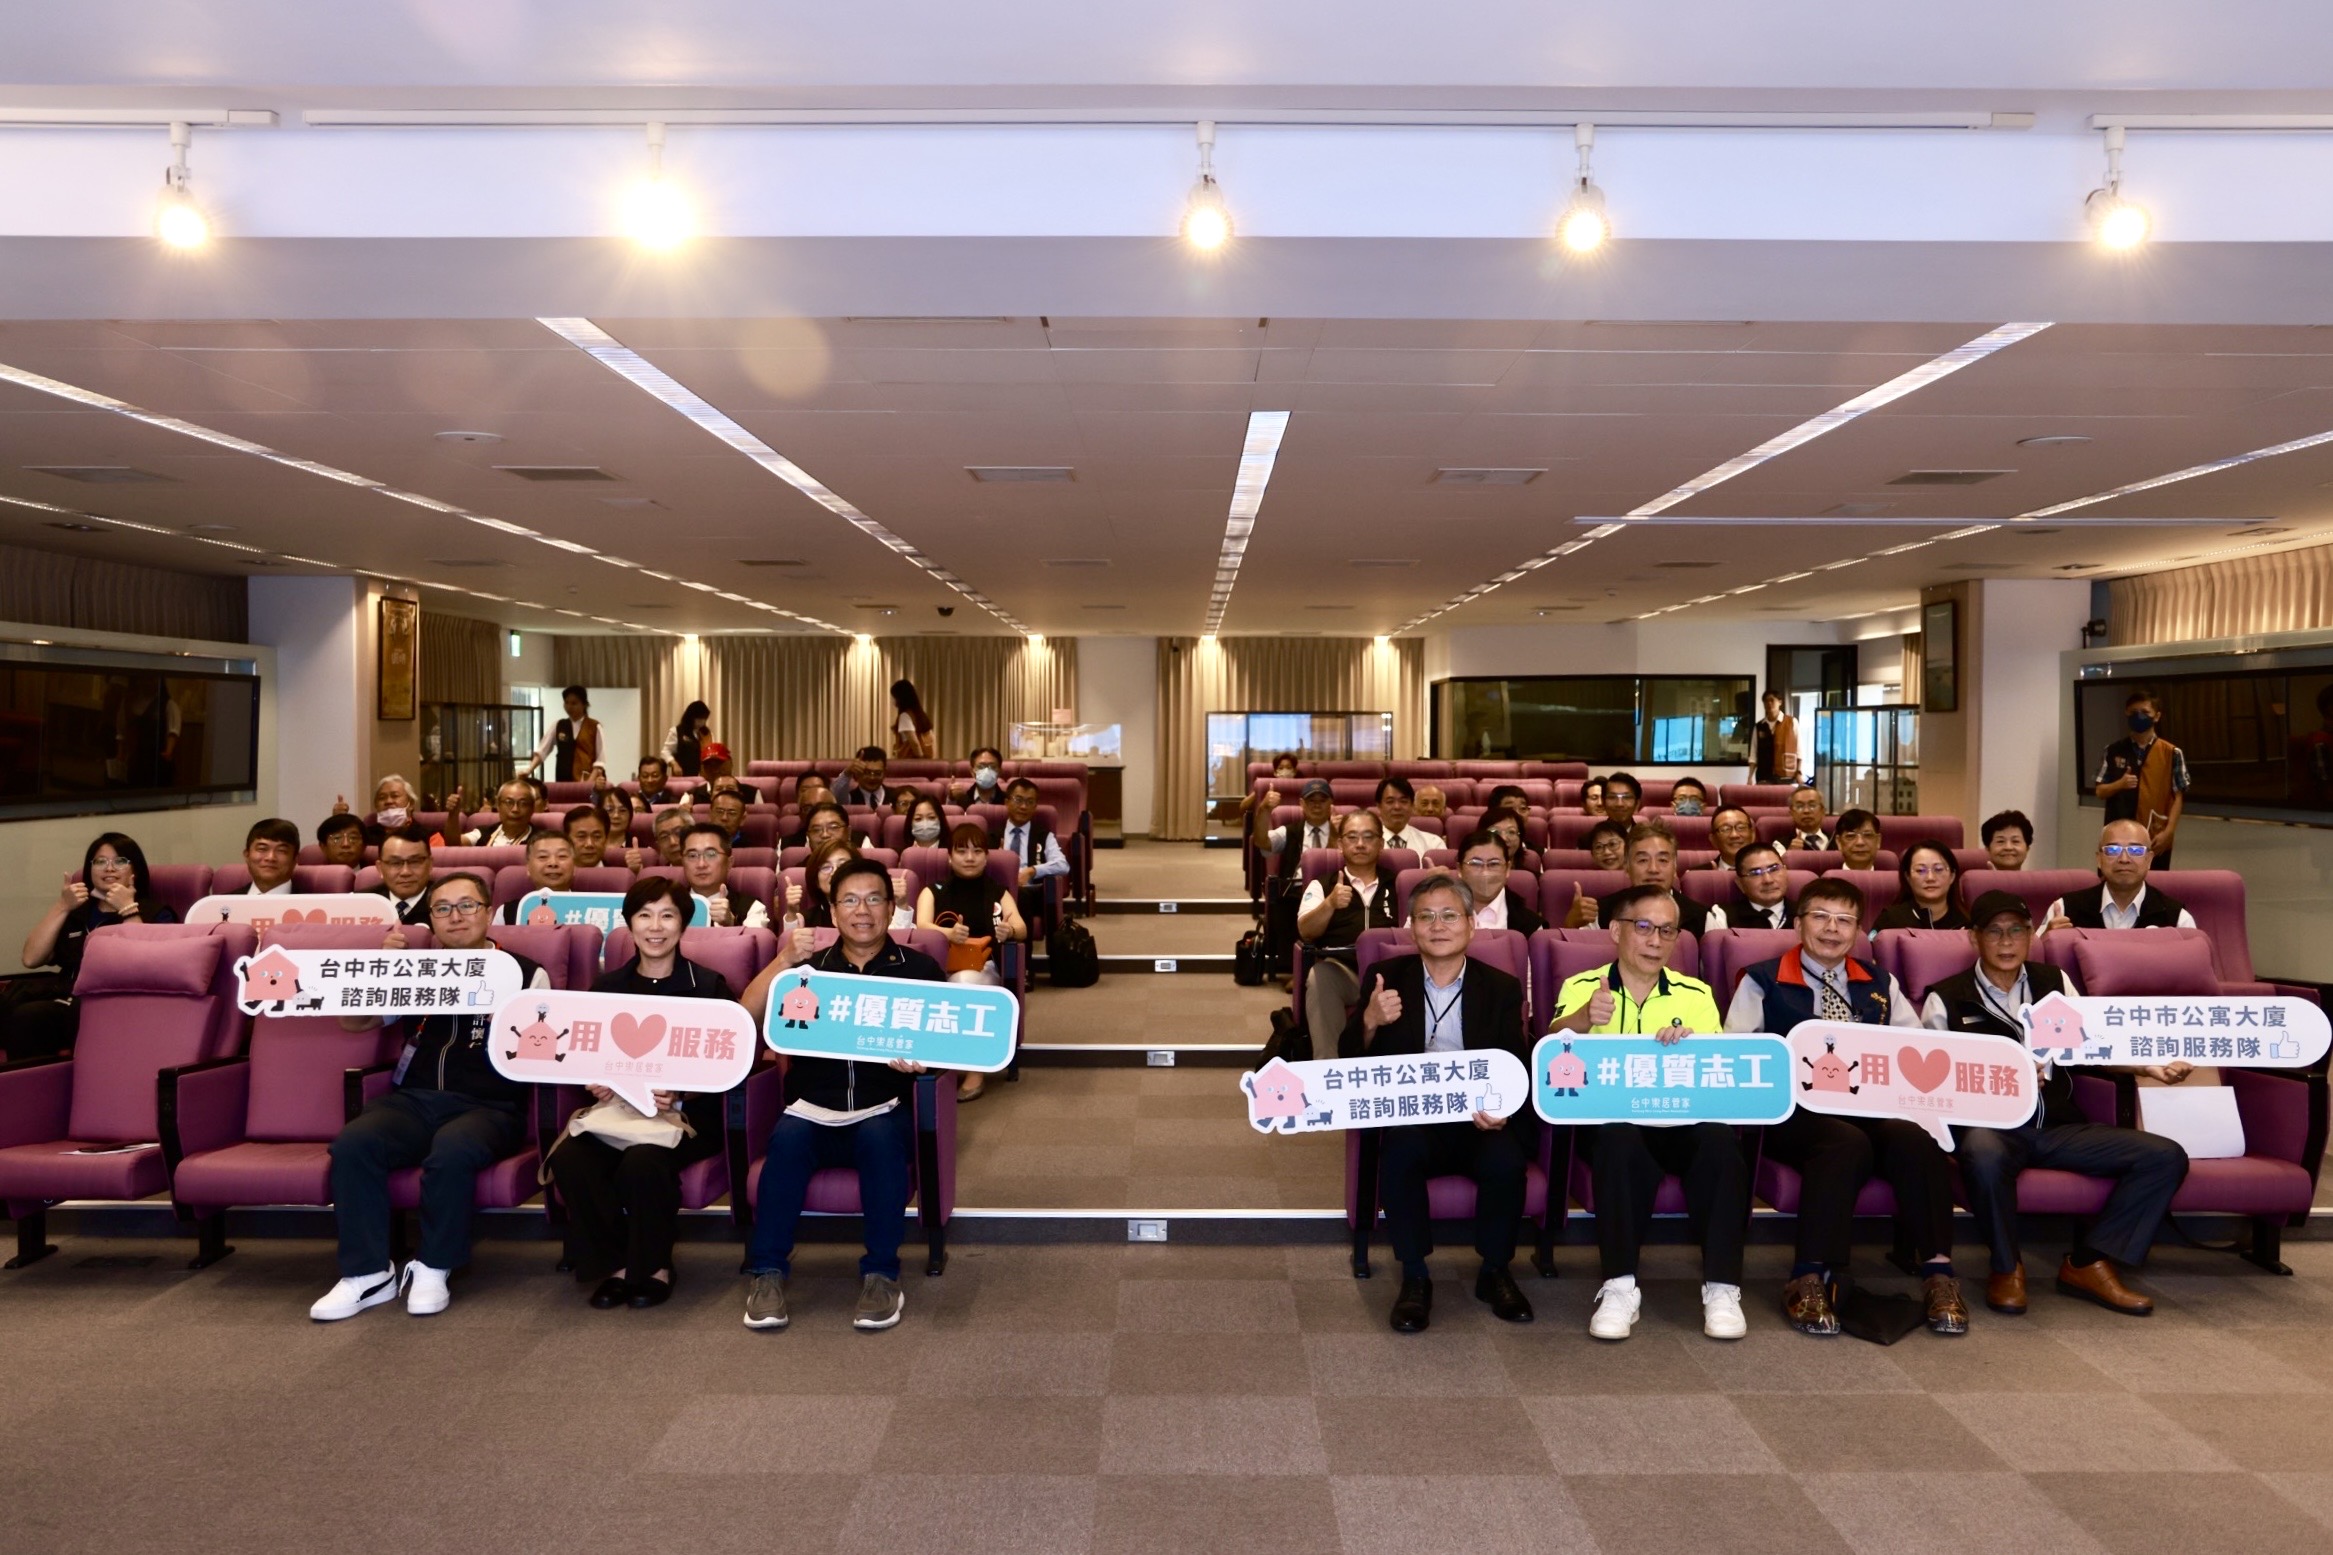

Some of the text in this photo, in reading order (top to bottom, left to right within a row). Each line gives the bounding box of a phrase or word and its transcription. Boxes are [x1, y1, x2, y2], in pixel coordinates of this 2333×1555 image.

[319, 957, 487, 980] 台中市公寓大廈
[341, 986, 462, 1009] 諮詢服務隊
[828, 993, 997, 1038] #優質志工
[2102, 1005, 2288, 1029] 台中市公寓大廈
[569, 1020, 738, 1061] 用 服務
[2129, 1035, 2263, 1060] 諮詢服務隊
[1322, 1058, 1492, 1092] 台中市公寓大廈
[1597, 1053, 1775, 1089] #優質志工
[1860, 1052, 2021, 1098] 用 服務
[1348, 1091, 1470, 1121] 諮詢服務隊
